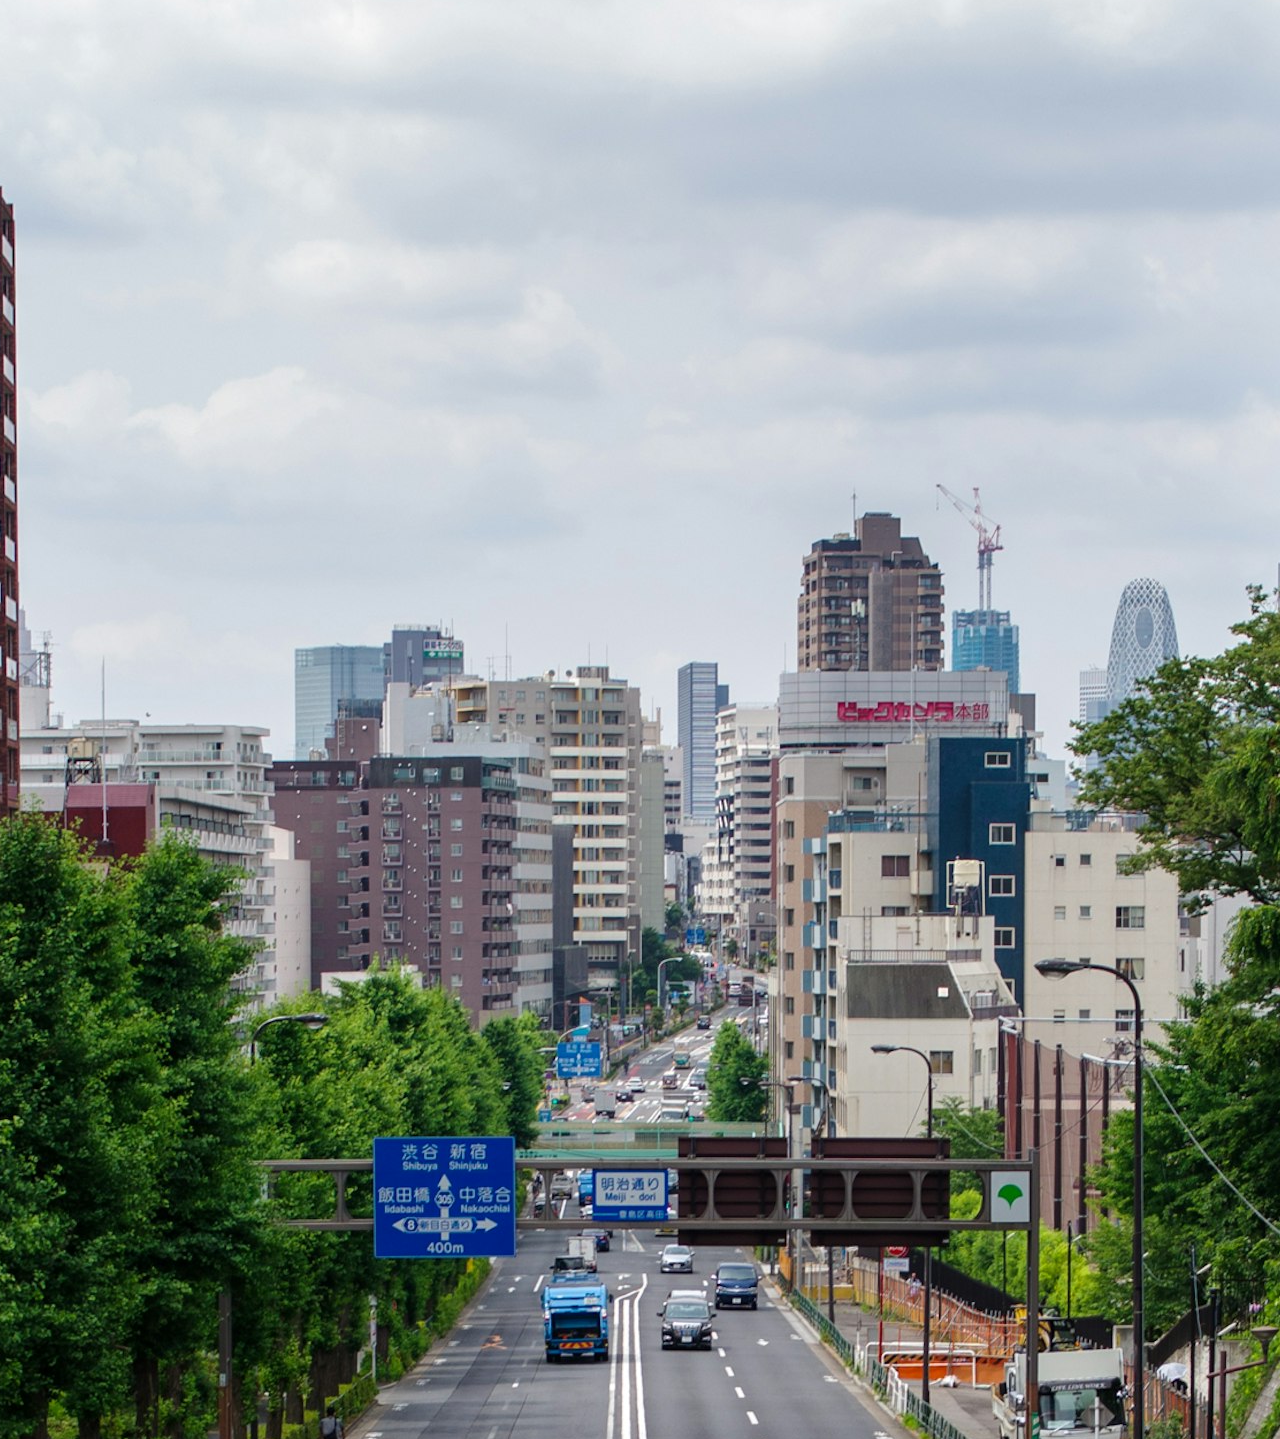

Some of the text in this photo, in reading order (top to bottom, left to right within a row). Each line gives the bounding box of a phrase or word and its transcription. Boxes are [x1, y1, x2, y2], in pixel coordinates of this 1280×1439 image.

[402, 1144, 487, 1160] 渋谷 新宿
[402, 1162, 488, 1172] Shibuya Shinjuku
[601, 1177, 659, 1191] 明治通り
[378, 1186, 430, 1203] 飯田橋
[437, 1195, 452, 1204] 305
[459, 1186, 511, 1203] 中落合
[605, 1192, 626, 1202] Meiji
[639, 1192, 656, 1201] dori
[384, 1205, 424, 1213] Iidabashi
[461, 1205, 510, 1213] Nakaochiai
[407, 1220, 415, 1231] 8
[427, 1242, 464, 1253] 400m
